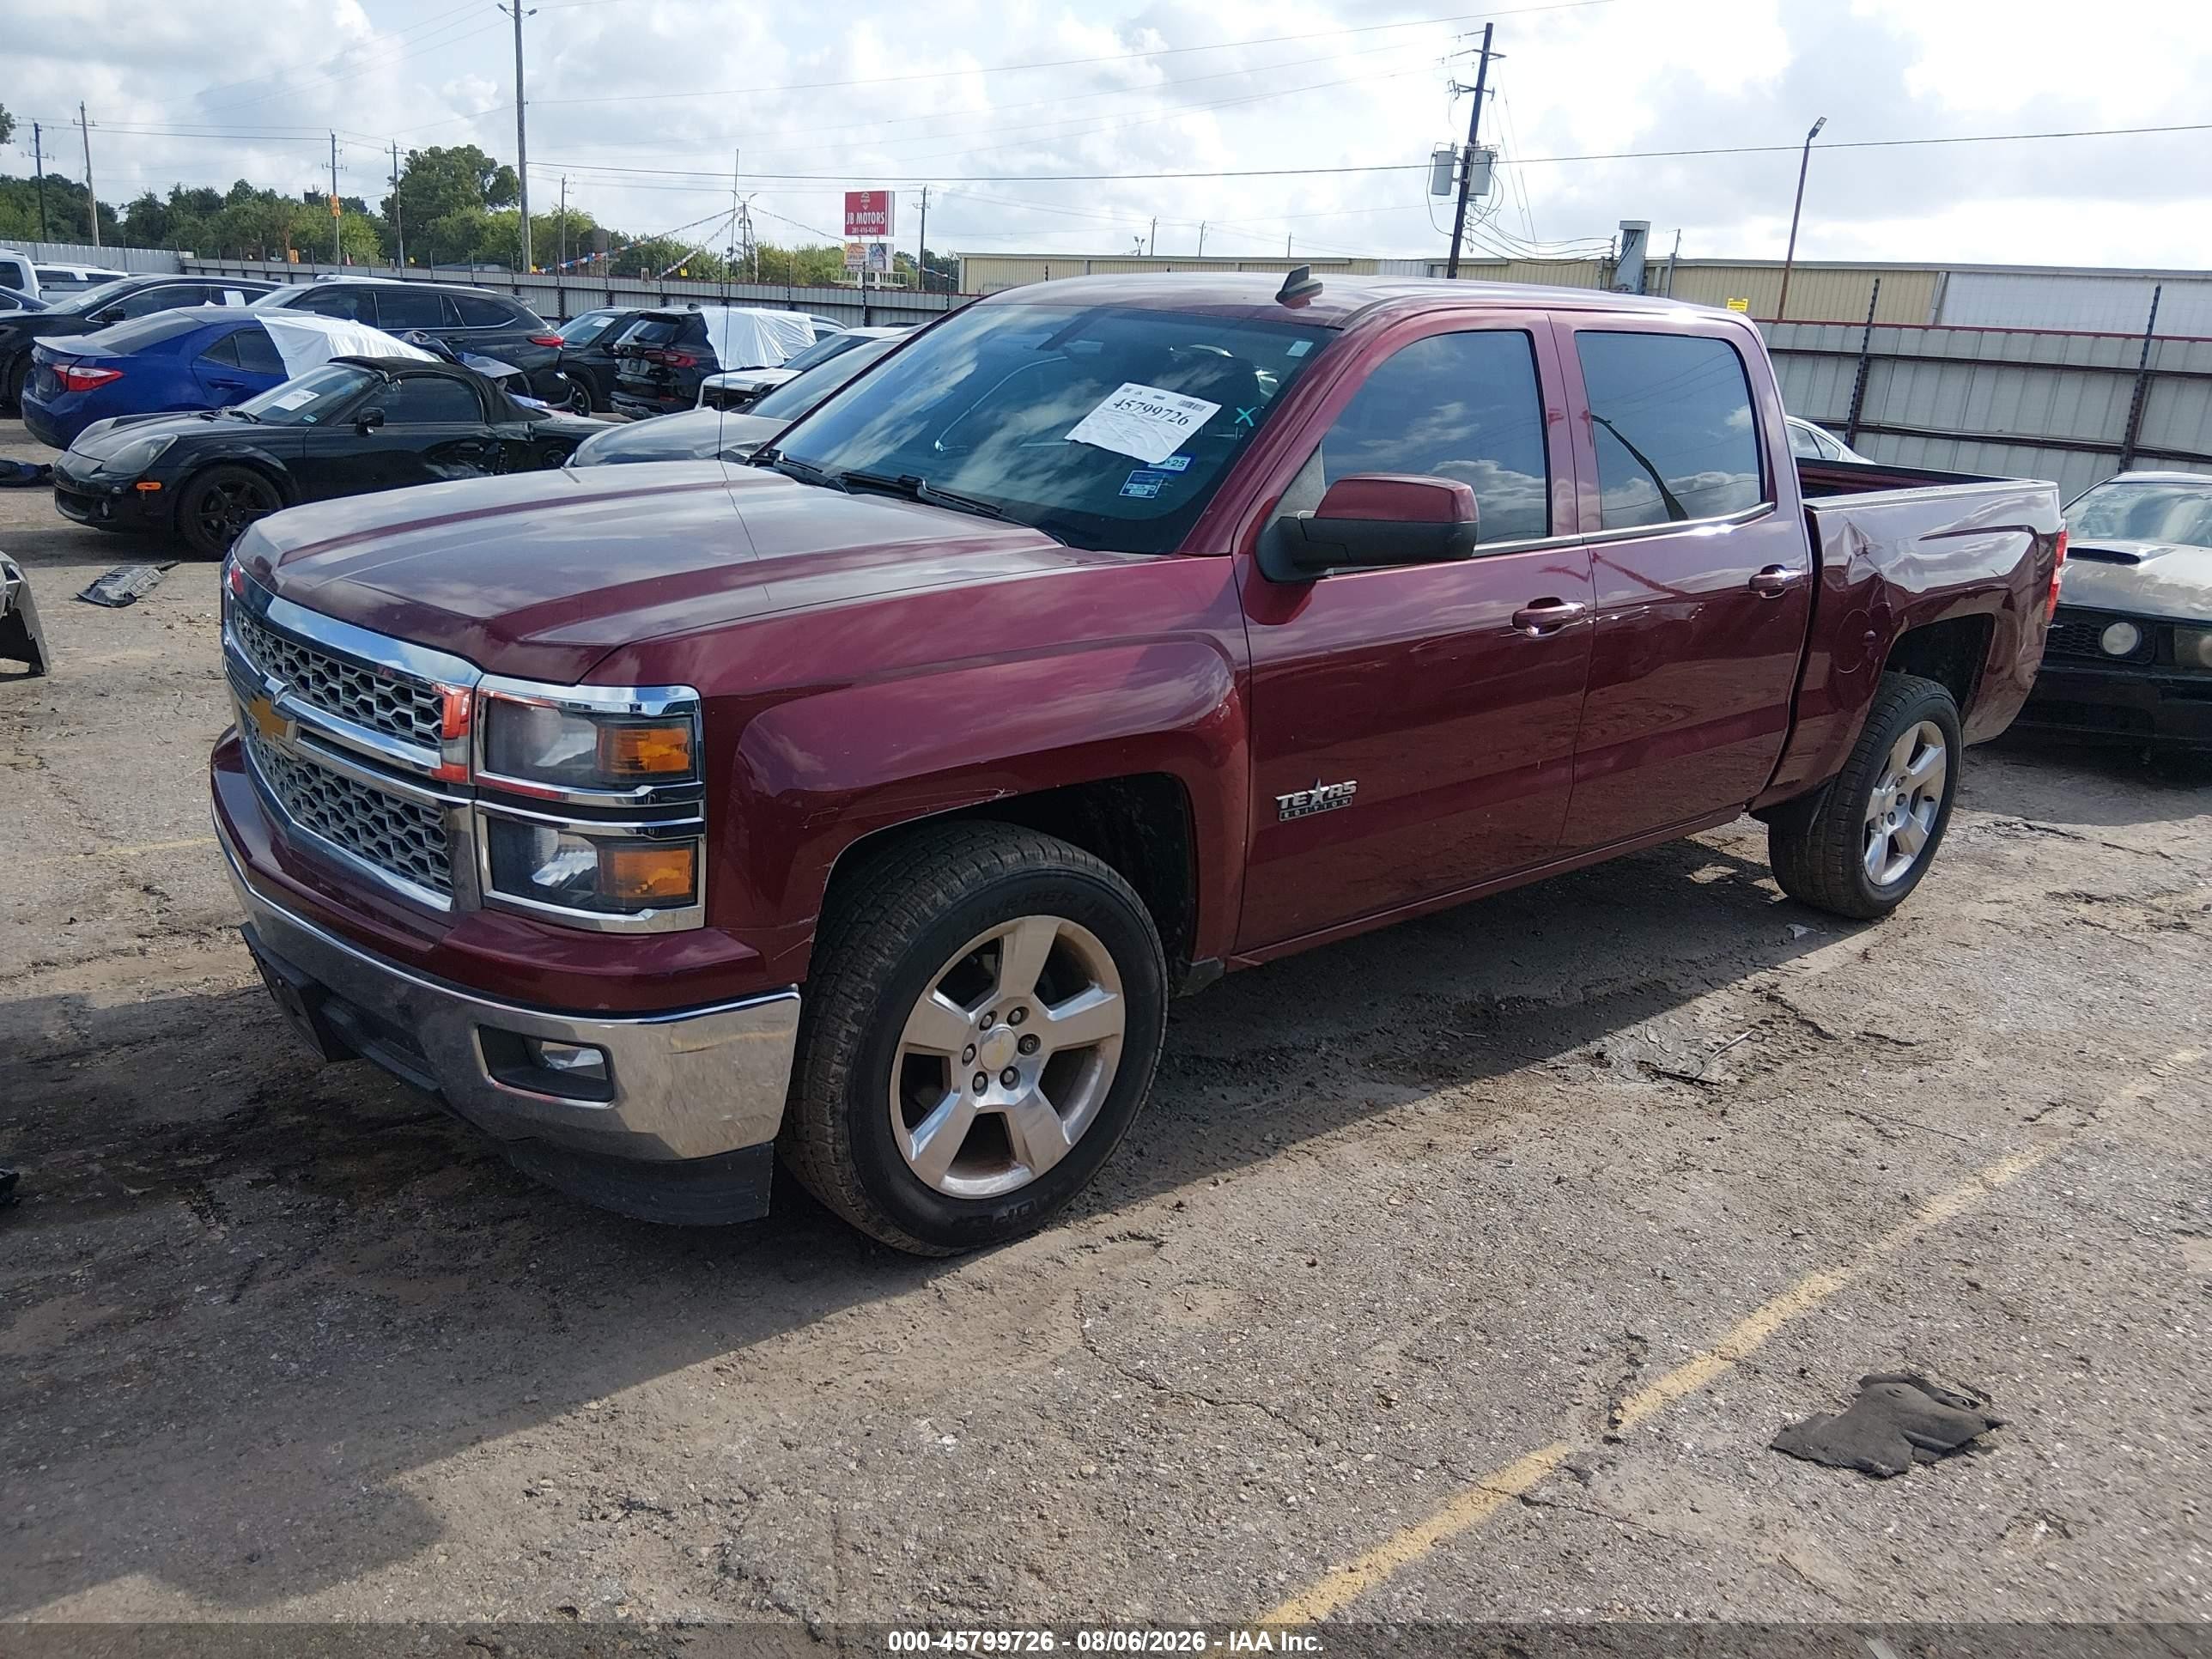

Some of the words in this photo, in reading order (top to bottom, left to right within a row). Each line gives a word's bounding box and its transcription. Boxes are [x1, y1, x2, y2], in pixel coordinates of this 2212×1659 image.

[847, 212, 854, 225] JB
[856, 211, 884, 225] MOTORS
[1113, 398, 1195, 427] 45799726
[1274, 779, 1358, 810] TEXAS
[1283, 799, 1349, 819] EDITION
